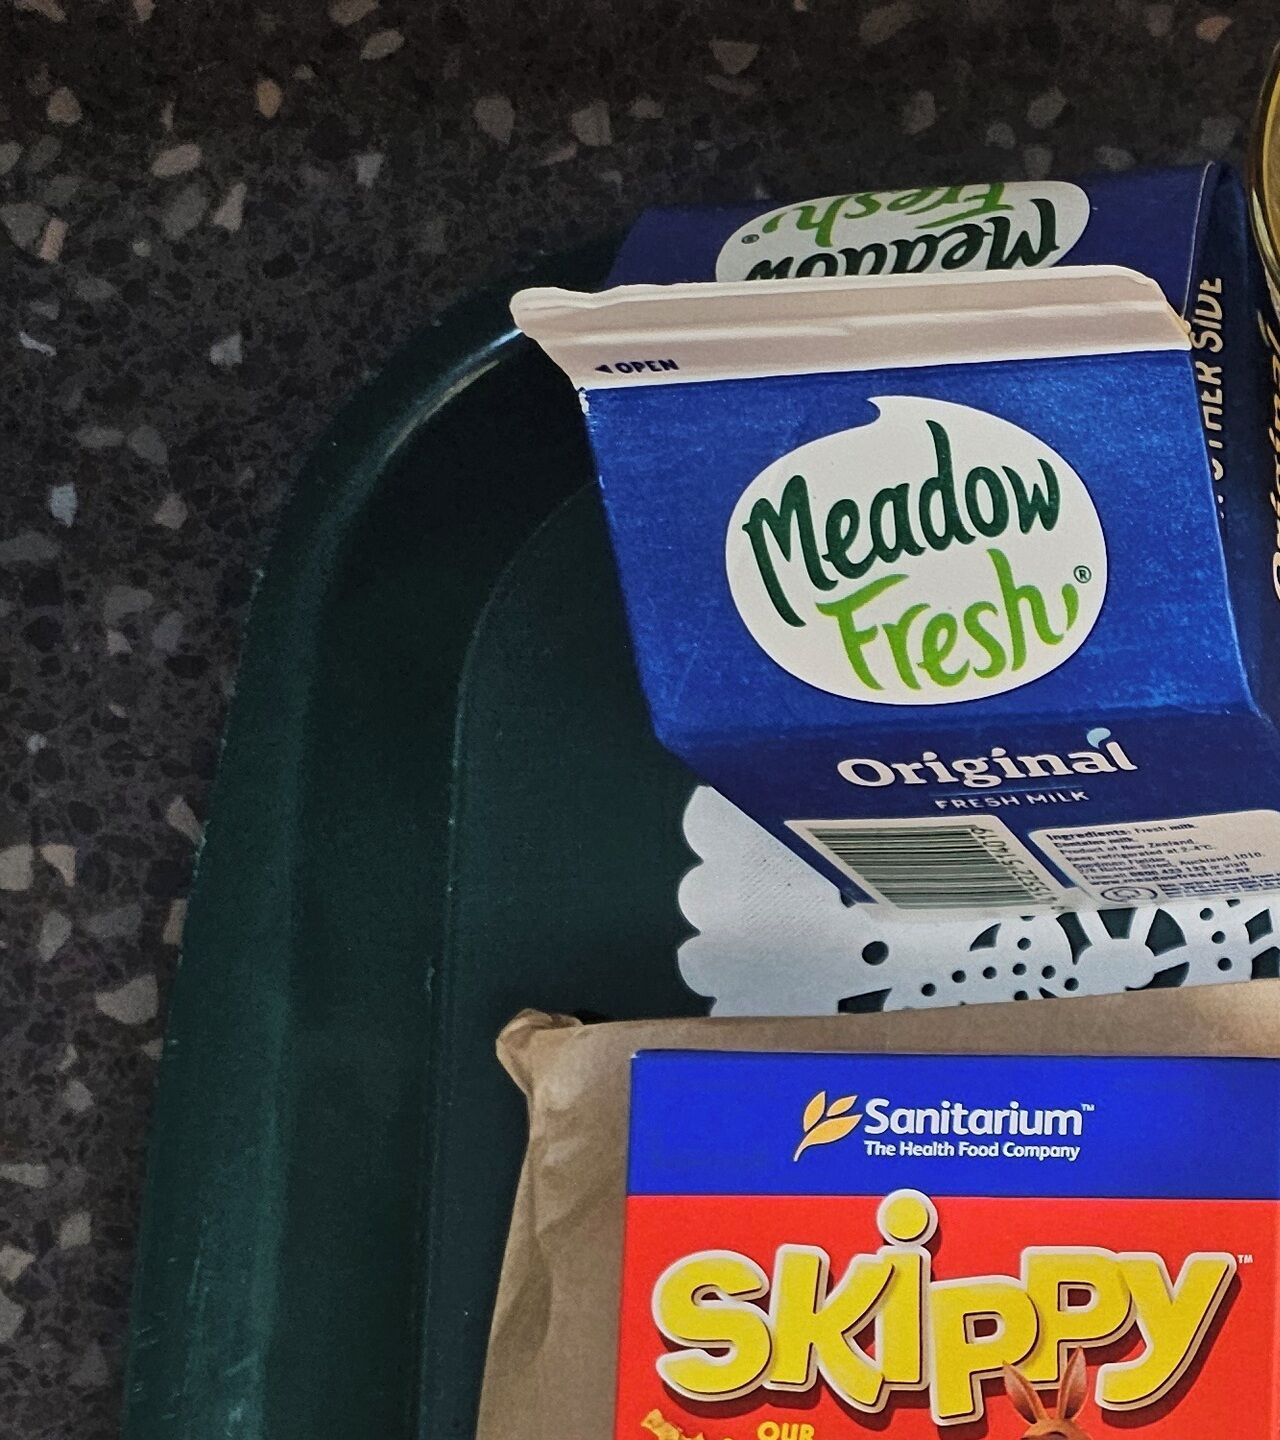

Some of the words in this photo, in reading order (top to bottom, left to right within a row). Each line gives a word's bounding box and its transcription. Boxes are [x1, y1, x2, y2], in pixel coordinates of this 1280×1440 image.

[614, 359, 680, 373] OPEN
[742, 420, 1063, 629] Meadow
[816, 550, 1080, 692] Fresh
[837, 738, 1138, 788] Original
[935, 795, 1021, 811] FRESH
[1026, 790, 1090, 806] MILK
[864, 1098, 1083, 1136] Sanitarium
[864, 1140, 897, 1156] The
[900, 1141, 951, 1157] Health
[958, 1141, 999, 1158] Food
[1002, 1142, 1080, 1162] Company
